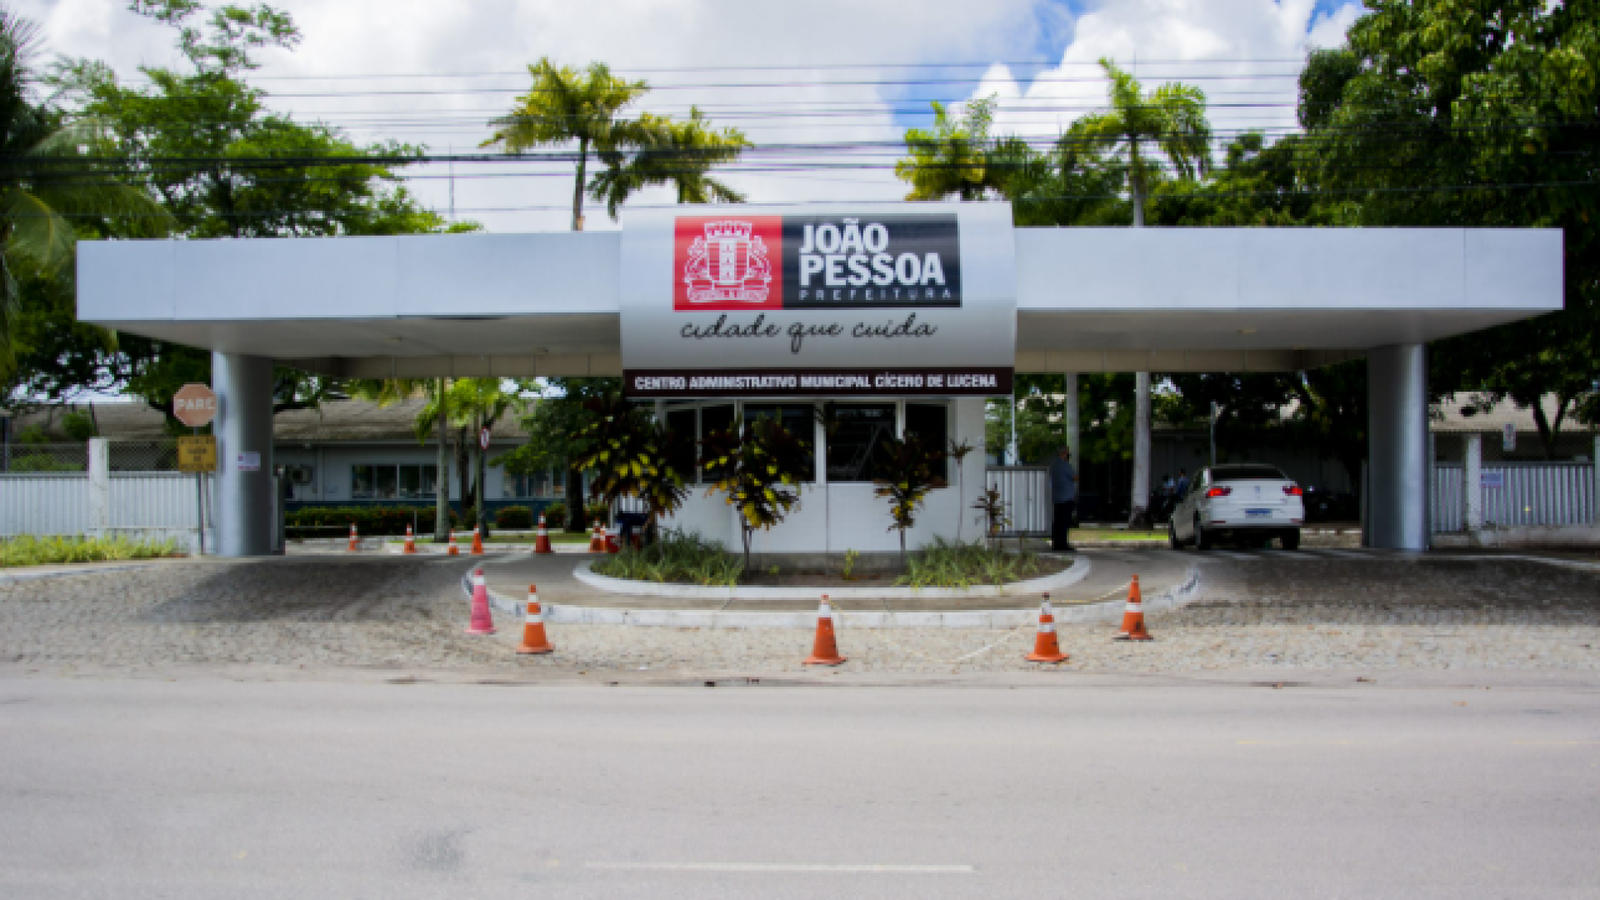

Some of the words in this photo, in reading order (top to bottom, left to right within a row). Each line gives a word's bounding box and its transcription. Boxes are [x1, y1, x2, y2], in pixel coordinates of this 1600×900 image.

[800, 217, 888, 254] JOÃO
[800, 253, 945, 286] PESSOA
[799, 289, 952, 301] PREFEITURA
[680, 313, 781, 339] cidade
[787, 321, 843, 353] que
[852, 313, 938, 339] cuida
[635, 376, 685, 390] CENTRO
[689, 376, 797, 389] ADMINISTRATIVO
[801, 375, 871, 389] MUNICIPAL
[875, 372, 924, 388] CÍCERO
[927, 374, 944, 388] DE
[947, 374, 998, 388] LUCENA
[178, 398, 214, 411] PARE
